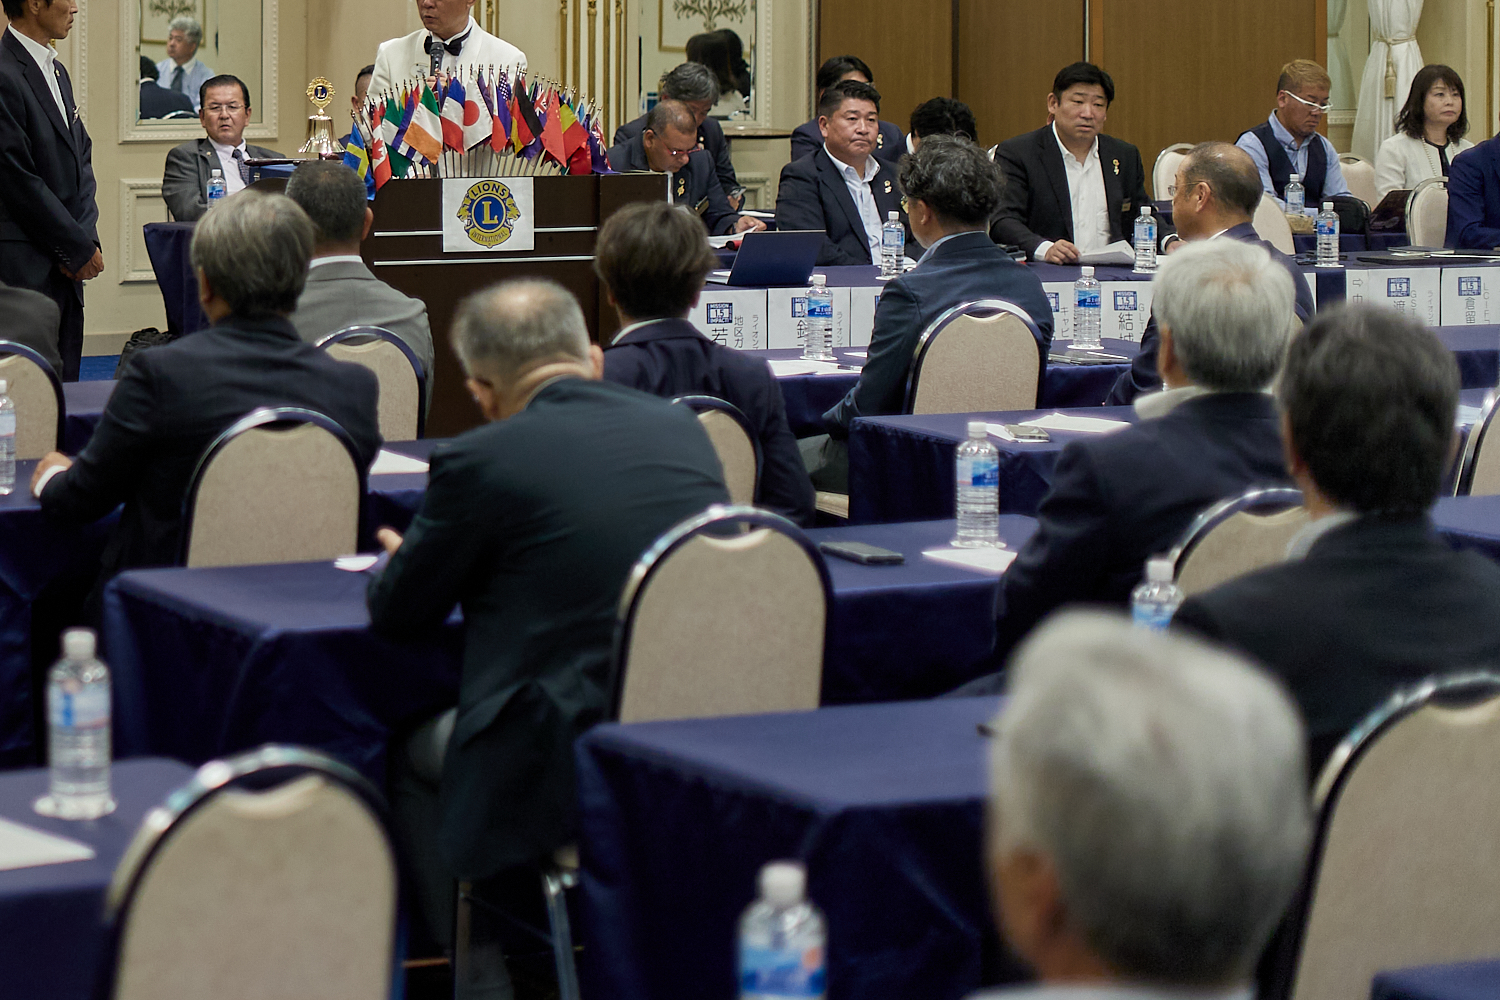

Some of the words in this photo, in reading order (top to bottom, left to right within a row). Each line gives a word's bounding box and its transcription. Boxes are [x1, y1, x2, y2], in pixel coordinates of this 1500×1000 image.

[470, 182, 507, 198] LIONS
[481, 201, 499, 225] L
[471, 230, 508, 243] INTERNATIONAL
